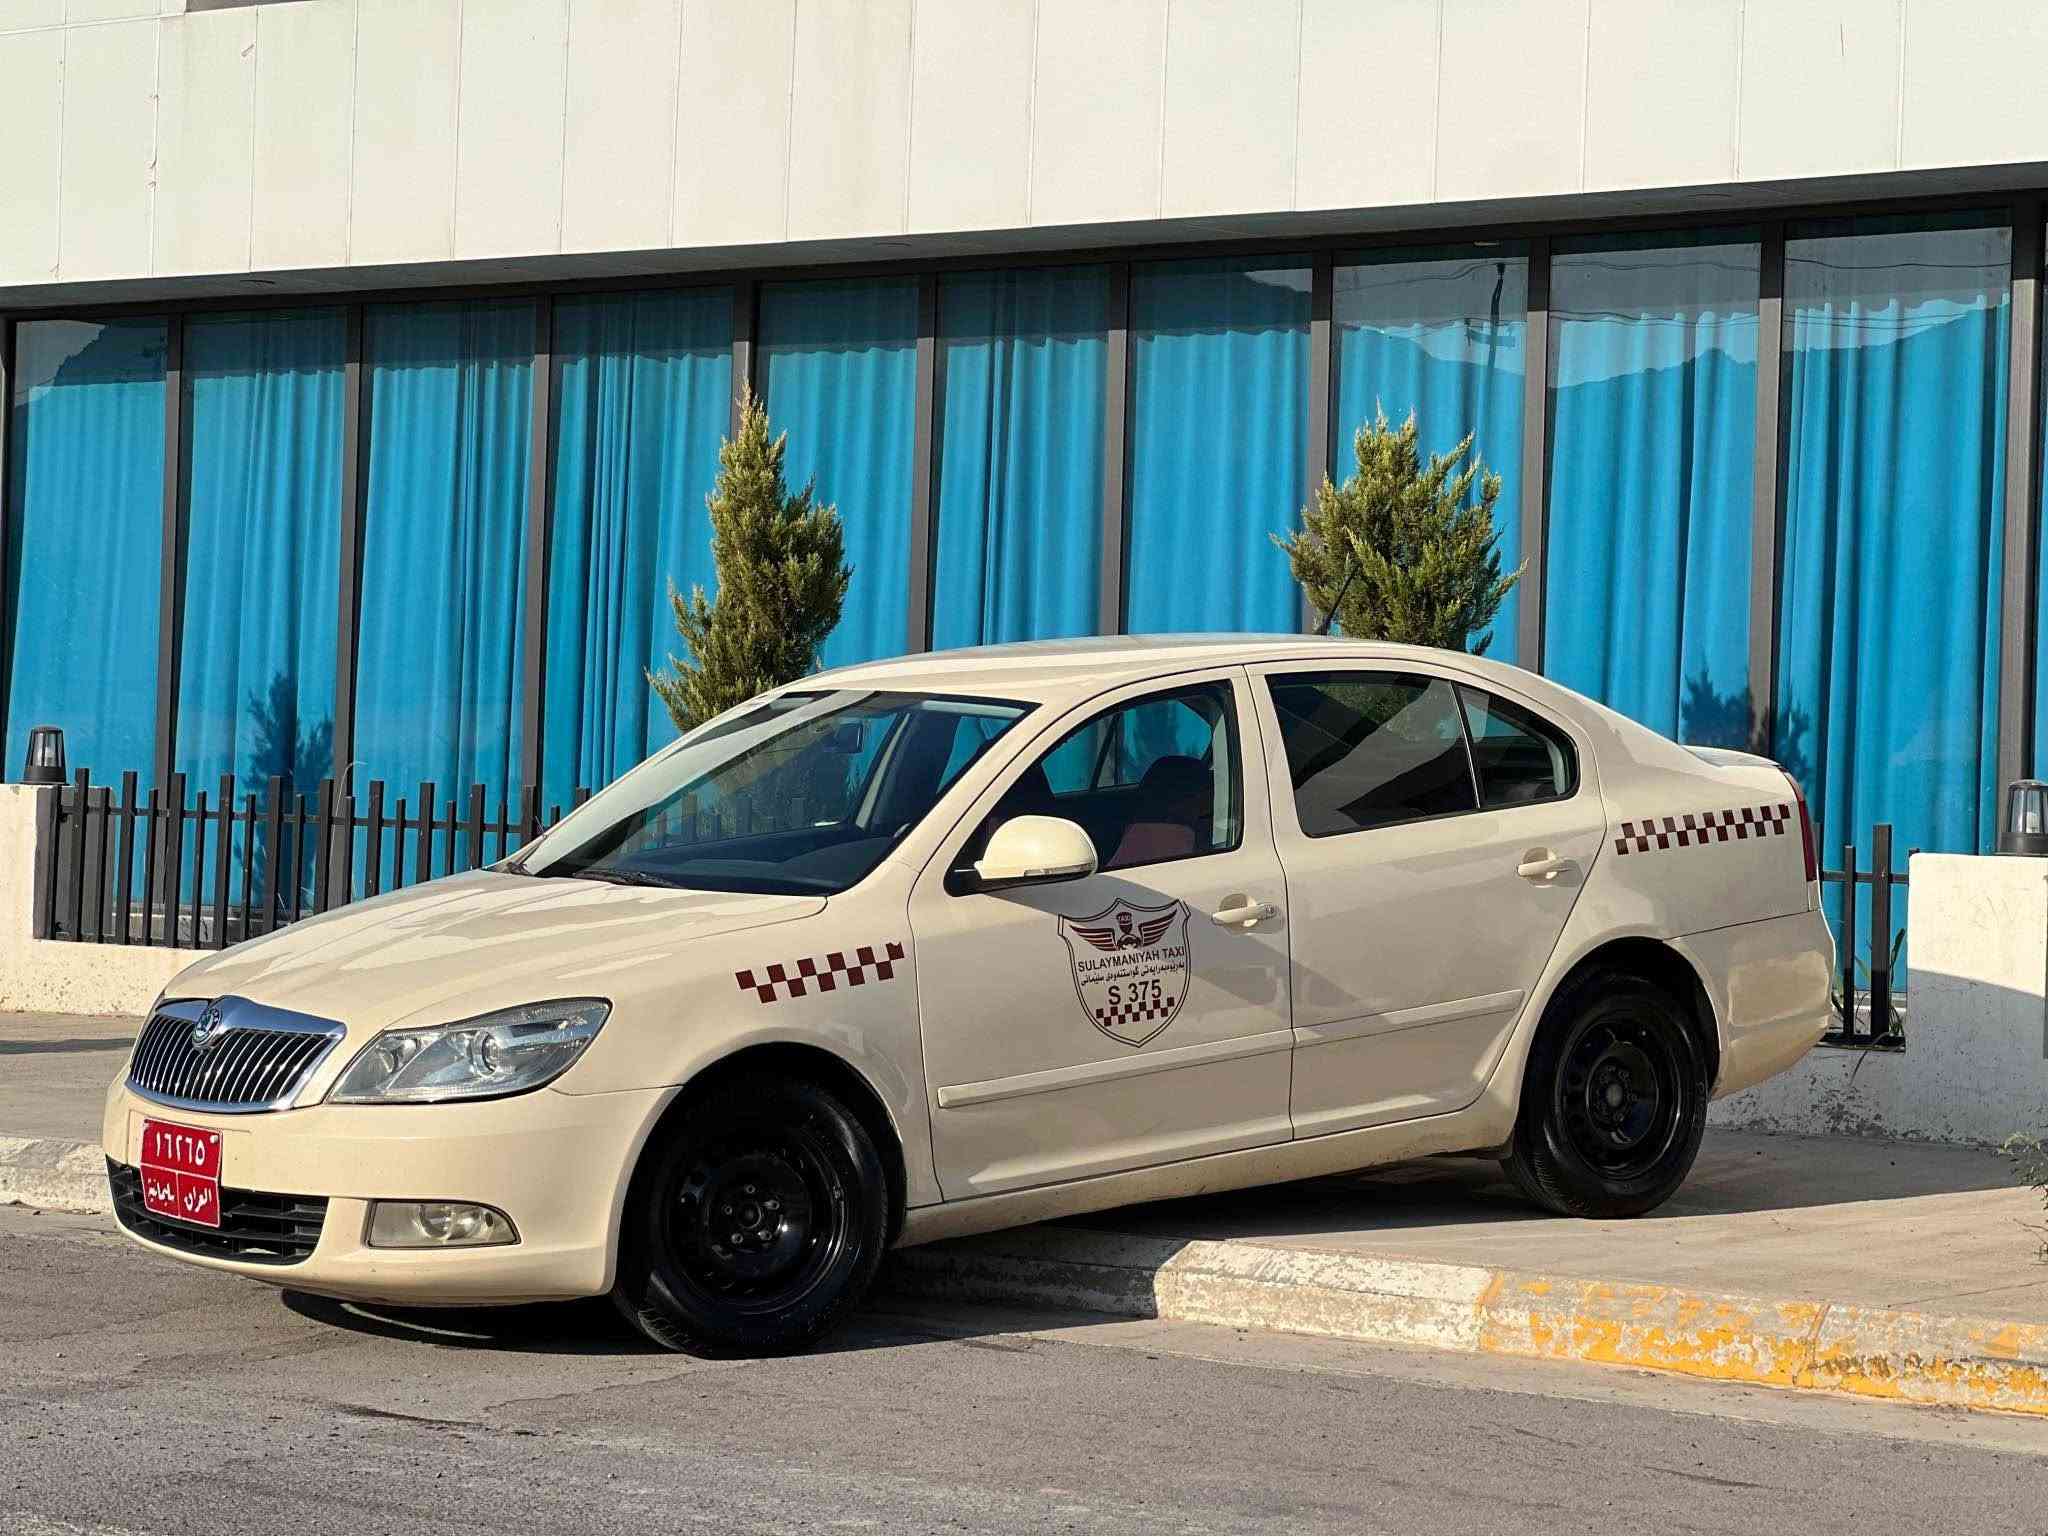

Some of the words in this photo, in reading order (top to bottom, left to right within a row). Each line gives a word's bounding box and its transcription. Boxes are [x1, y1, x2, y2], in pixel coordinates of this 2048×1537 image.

[1078, 950, 1160, 972] SULAYMANIYAH
[1160, 946, 1184, 959] TAXI
[1108, 985, 1120, 1005] S
[1128, 979, 1161, 1003] 375
